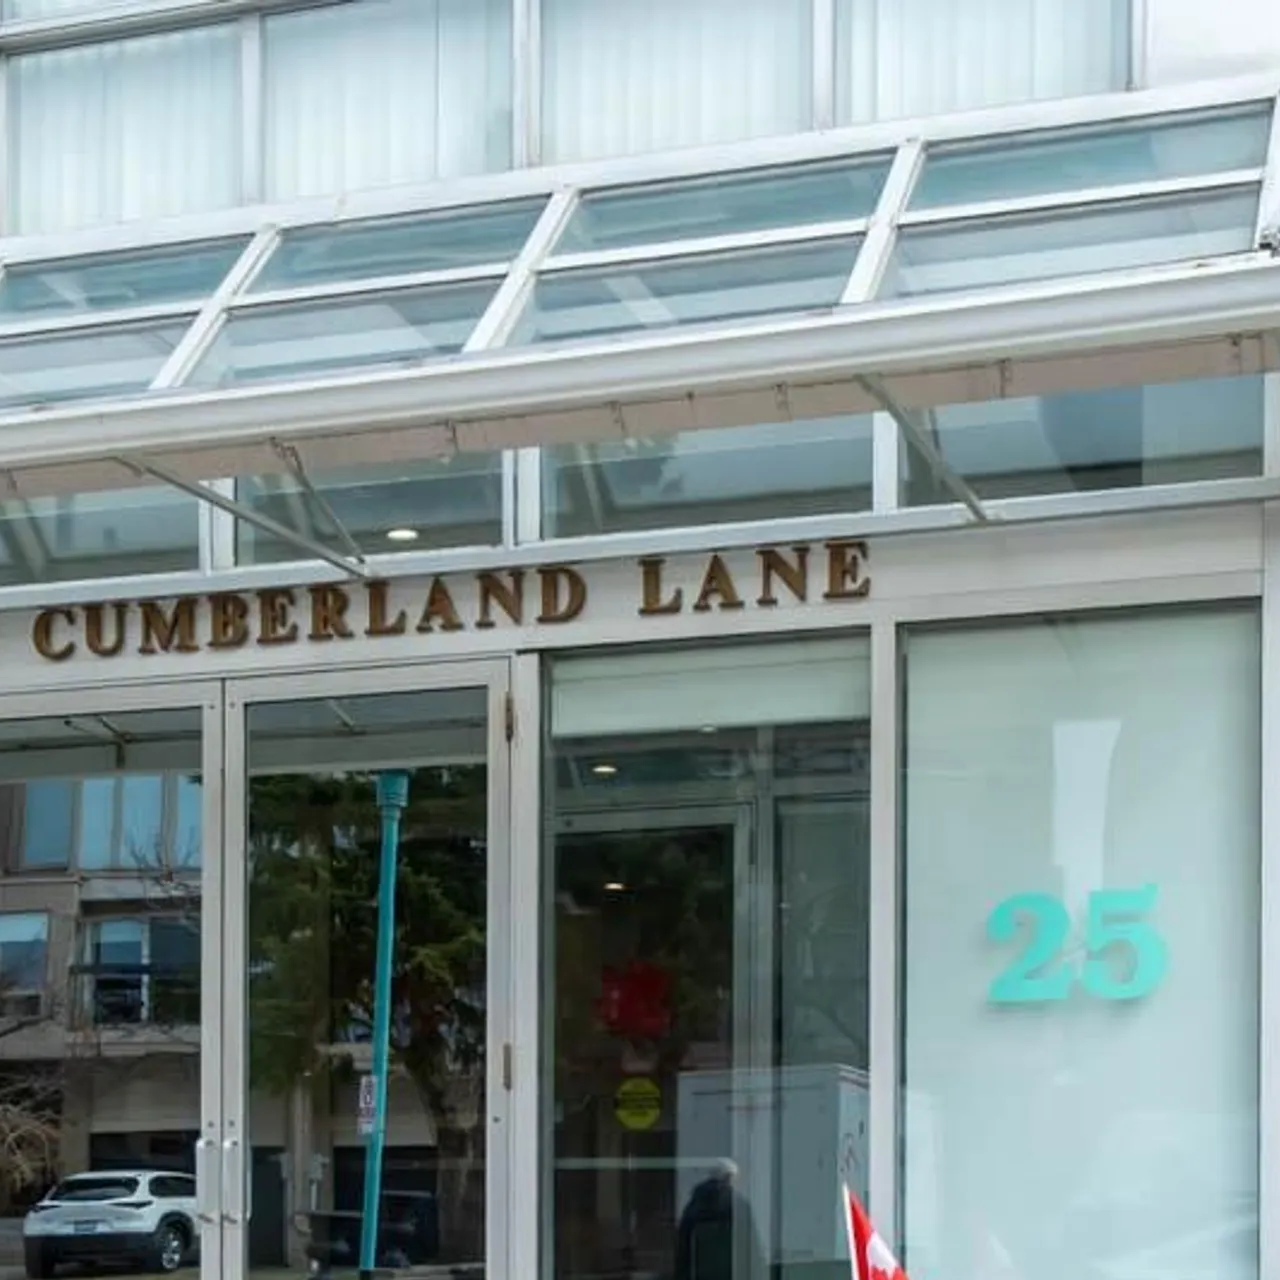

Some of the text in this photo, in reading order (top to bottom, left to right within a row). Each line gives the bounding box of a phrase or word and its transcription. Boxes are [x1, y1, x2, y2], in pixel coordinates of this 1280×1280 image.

[32, 565, 588, 661] CUMBERLAND
[637, 540, 870, 616] LANE
[985, 883, 1170, 1004] 25
